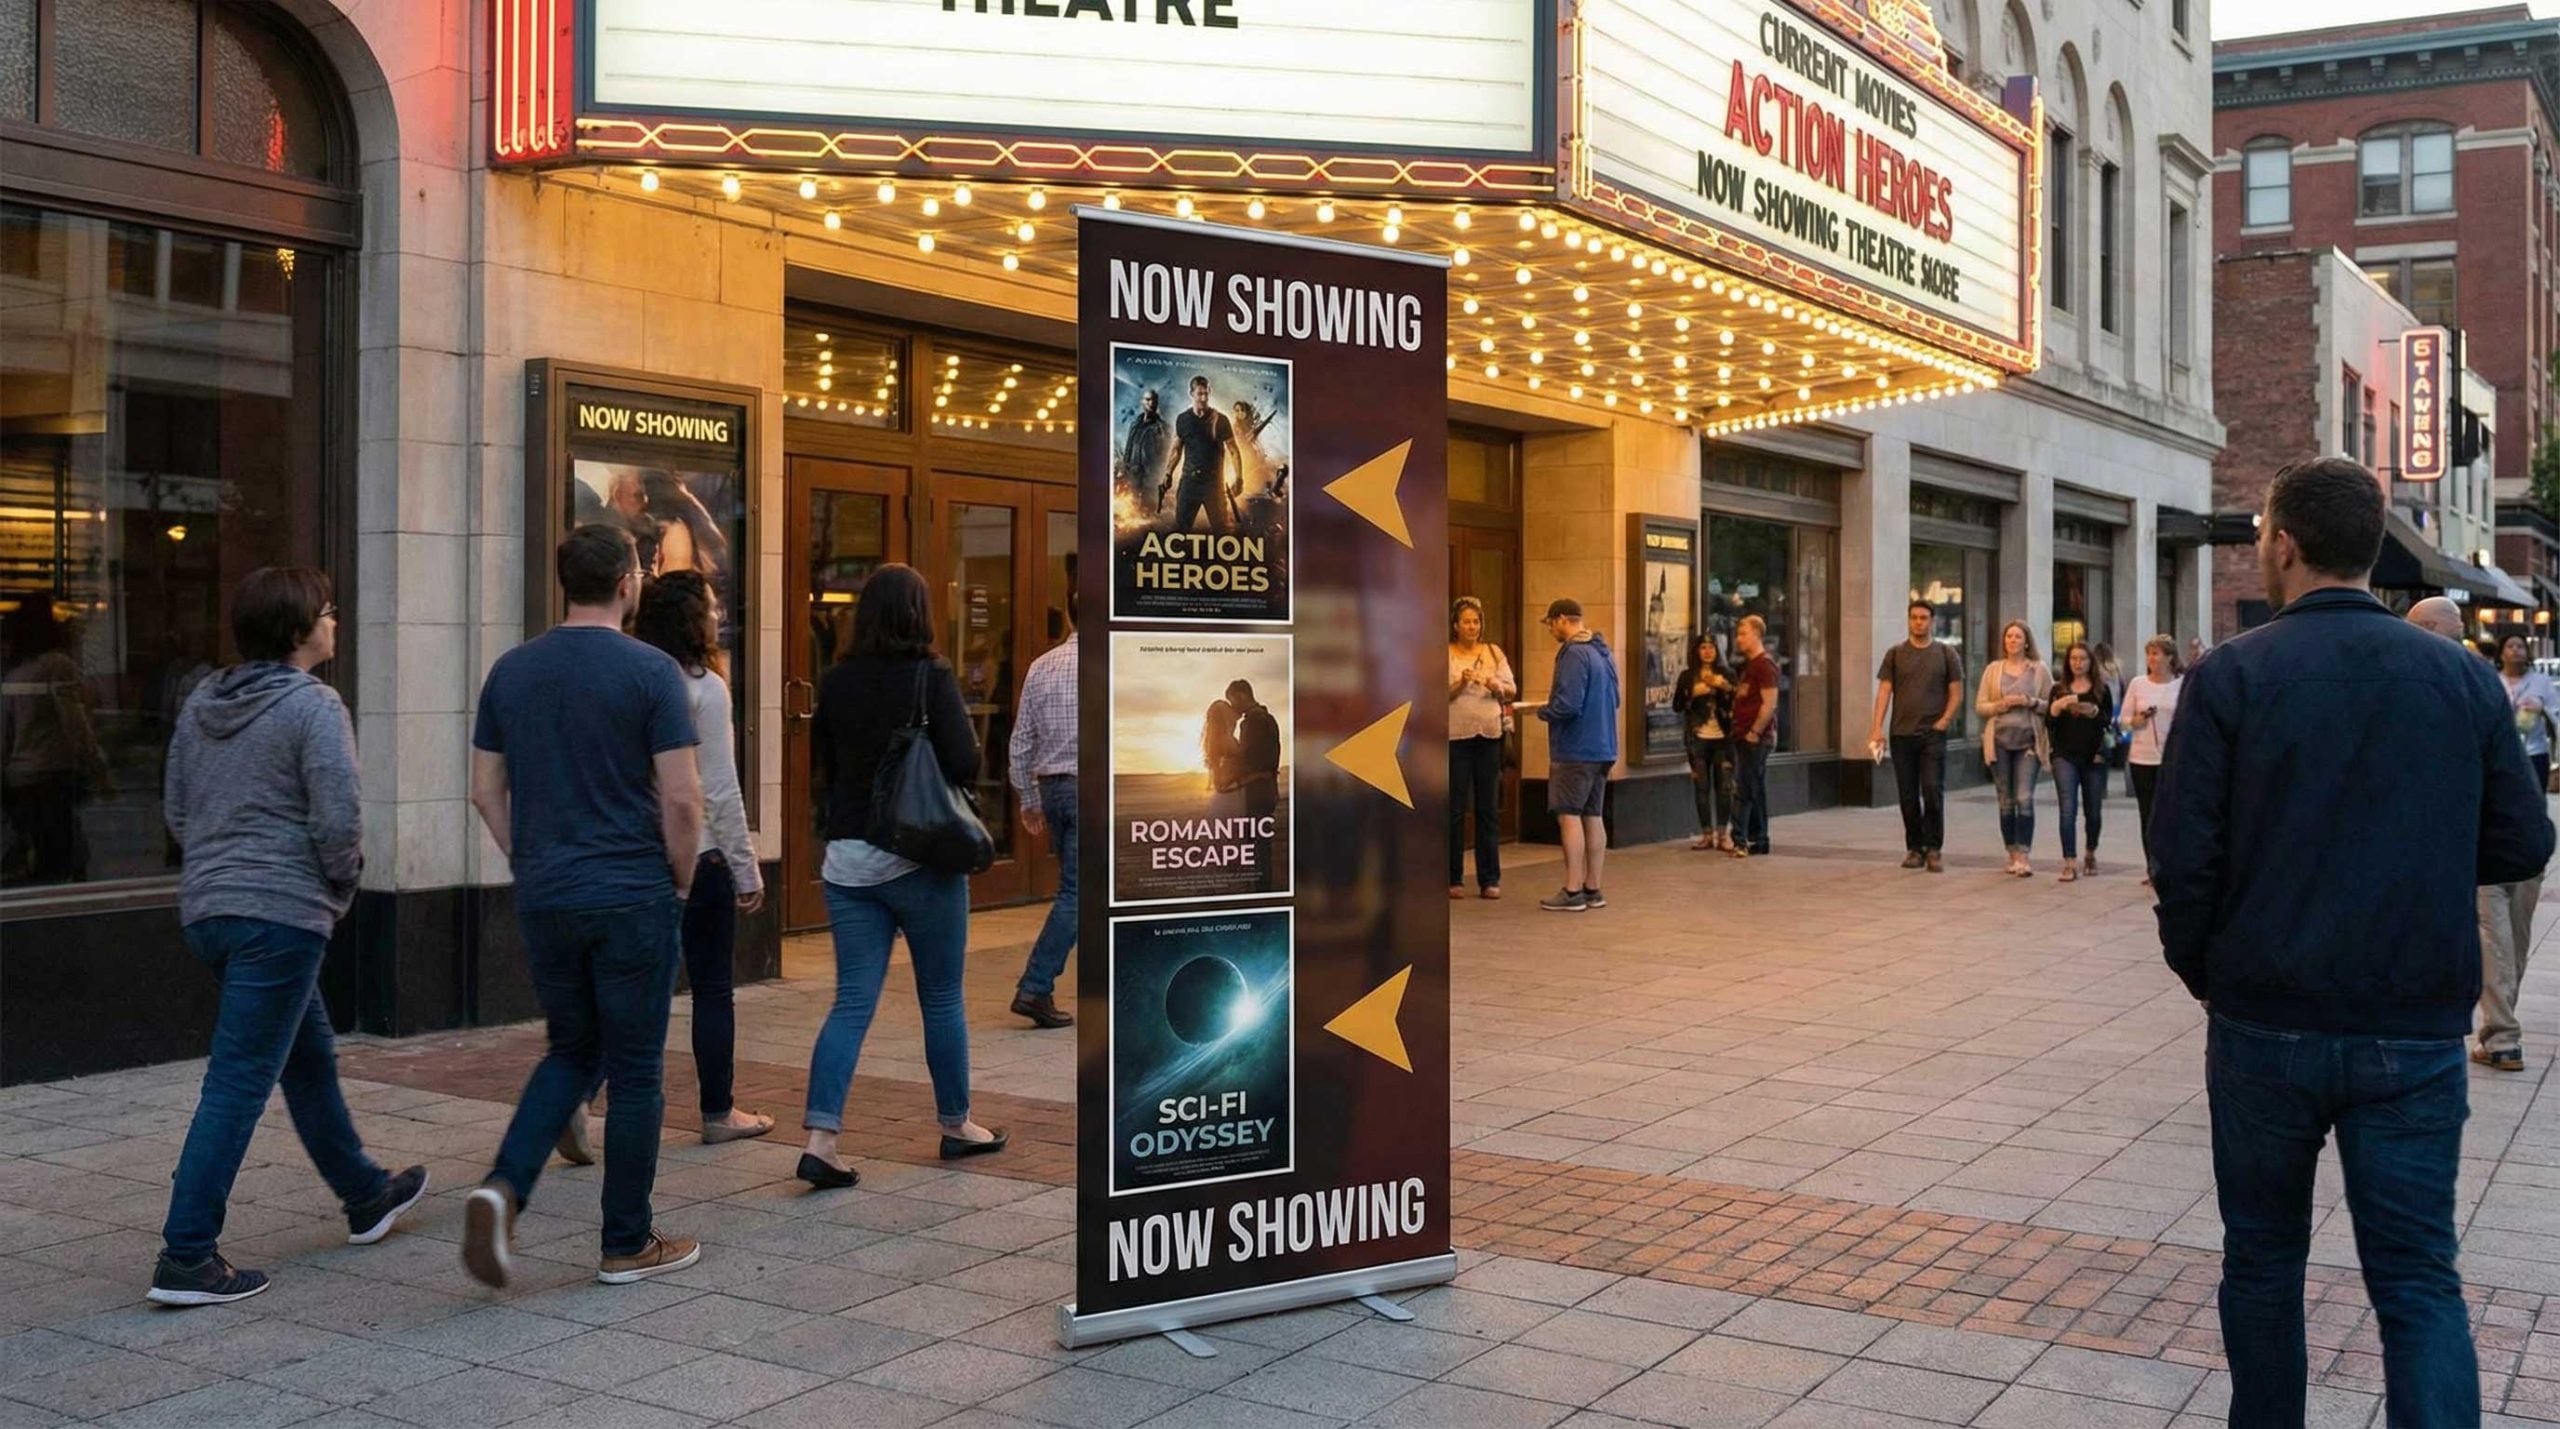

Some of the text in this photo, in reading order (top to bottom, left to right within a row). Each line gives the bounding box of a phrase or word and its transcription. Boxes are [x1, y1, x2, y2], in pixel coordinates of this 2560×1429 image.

[1760, 12, 1917, 140] CURRENT MOVIES
[1724, 59, 1953, 243] ACTION HEROES
[1697, 150, 1746, 213] NOW
[1753, 177, 1839, 252] SHOWING
[1845, 218, 1916, 287] THEATRE
[1110, 258, 1422, 352] NOW SHOWING
[580, 404, 728, 442] NOW SHOWING
[1139, 532, 1265, 562] ACTION
[1136, 562, 1269, 592] HEROES
[1131, 817, 1275, 843] ROMANTIC
[1152, 844, 1255, 869] ESCAPE
[1158, 1091, 1246, 1124] SCI-FI
[1130, 1118, 1275, 1158] ODYSSEY
[1109, 1177, 1425, 1282] NOW SHOWING
